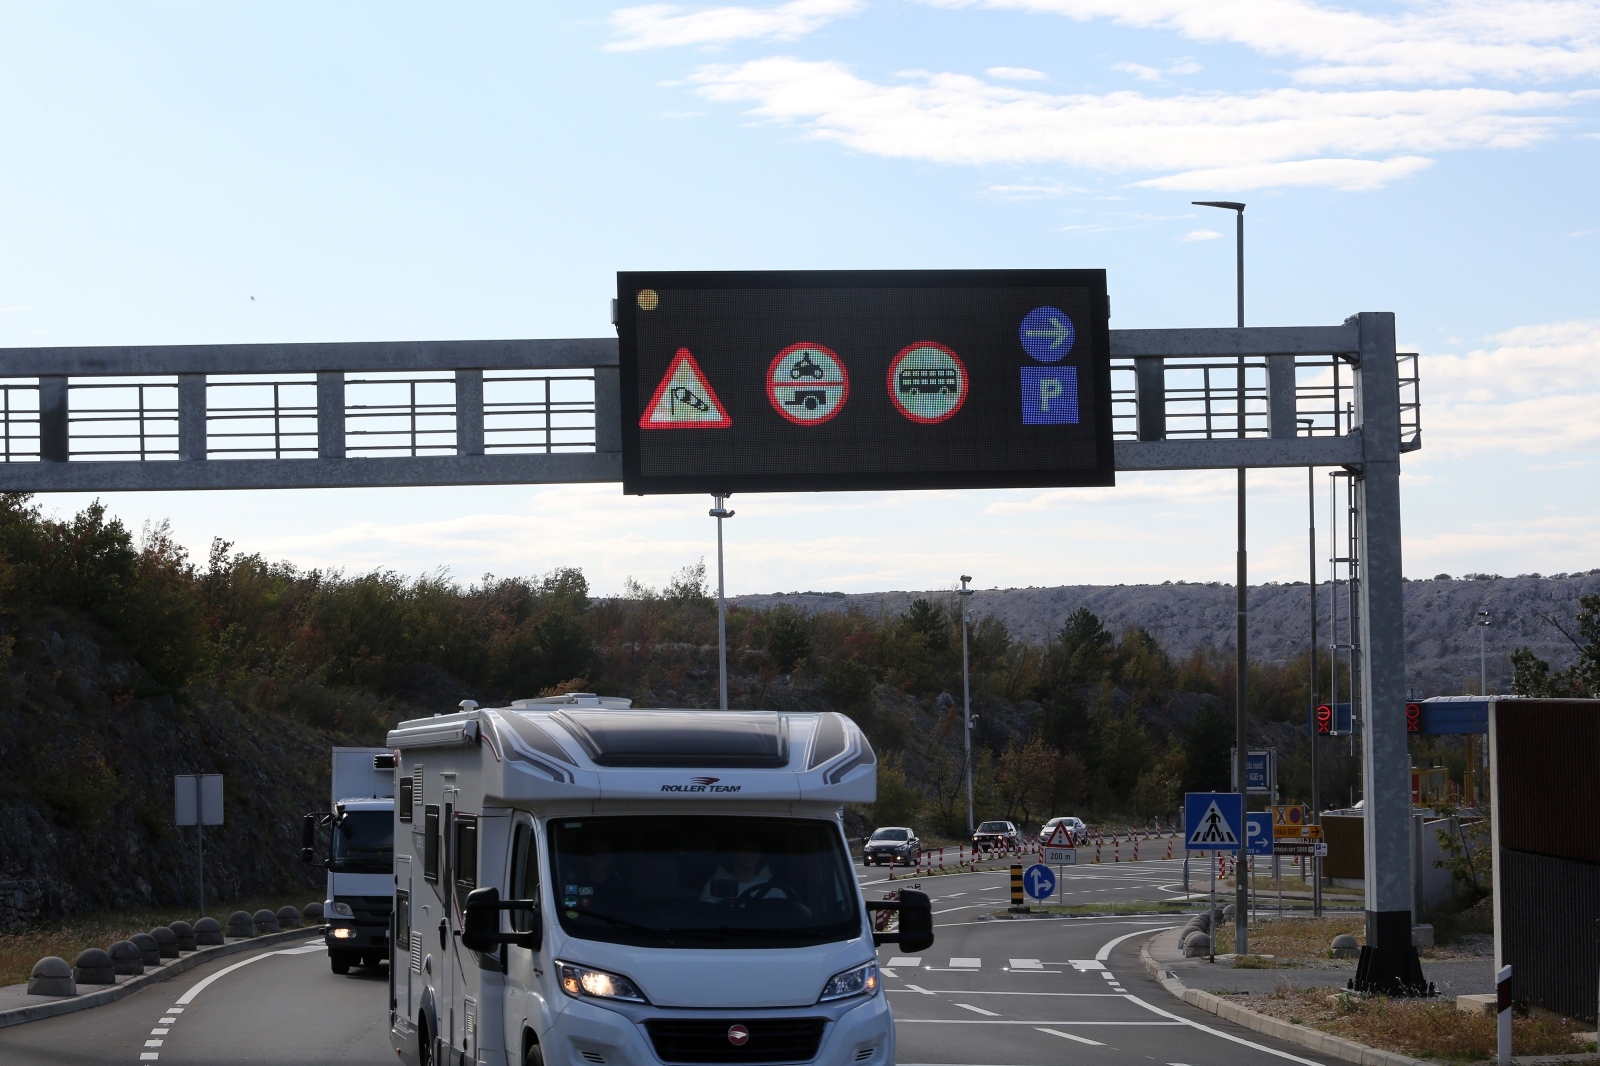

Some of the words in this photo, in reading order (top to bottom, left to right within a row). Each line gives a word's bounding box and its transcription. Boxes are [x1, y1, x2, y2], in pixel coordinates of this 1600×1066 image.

[1040, 378, 1063, 412] P
[709, 785, 741, 793] TEAM
[1246, 821, 1261, 847] P
[1050, 852, 1062, 860] 200
